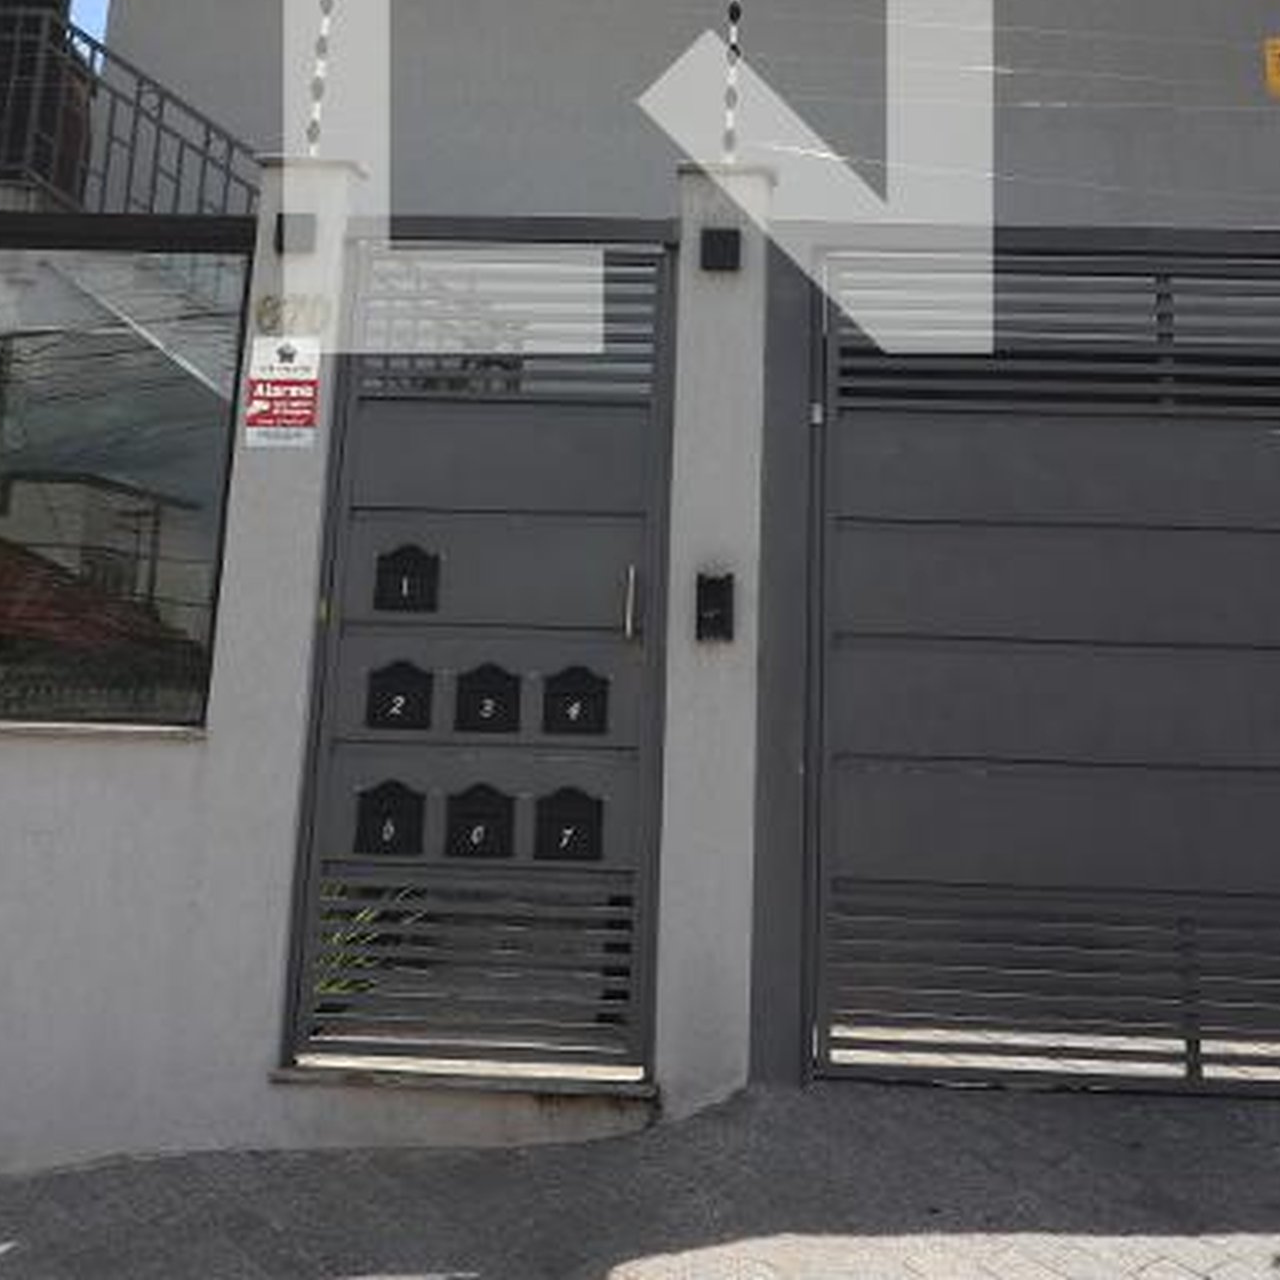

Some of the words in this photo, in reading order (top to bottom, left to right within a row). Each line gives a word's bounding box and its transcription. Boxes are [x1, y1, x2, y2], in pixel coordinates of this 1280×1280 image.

[389, 695, 405, 715] 2
[480, 699, 495, 718] 3
[567, 701, 581, 720] 4
[559, 827, 574, 847] 7
